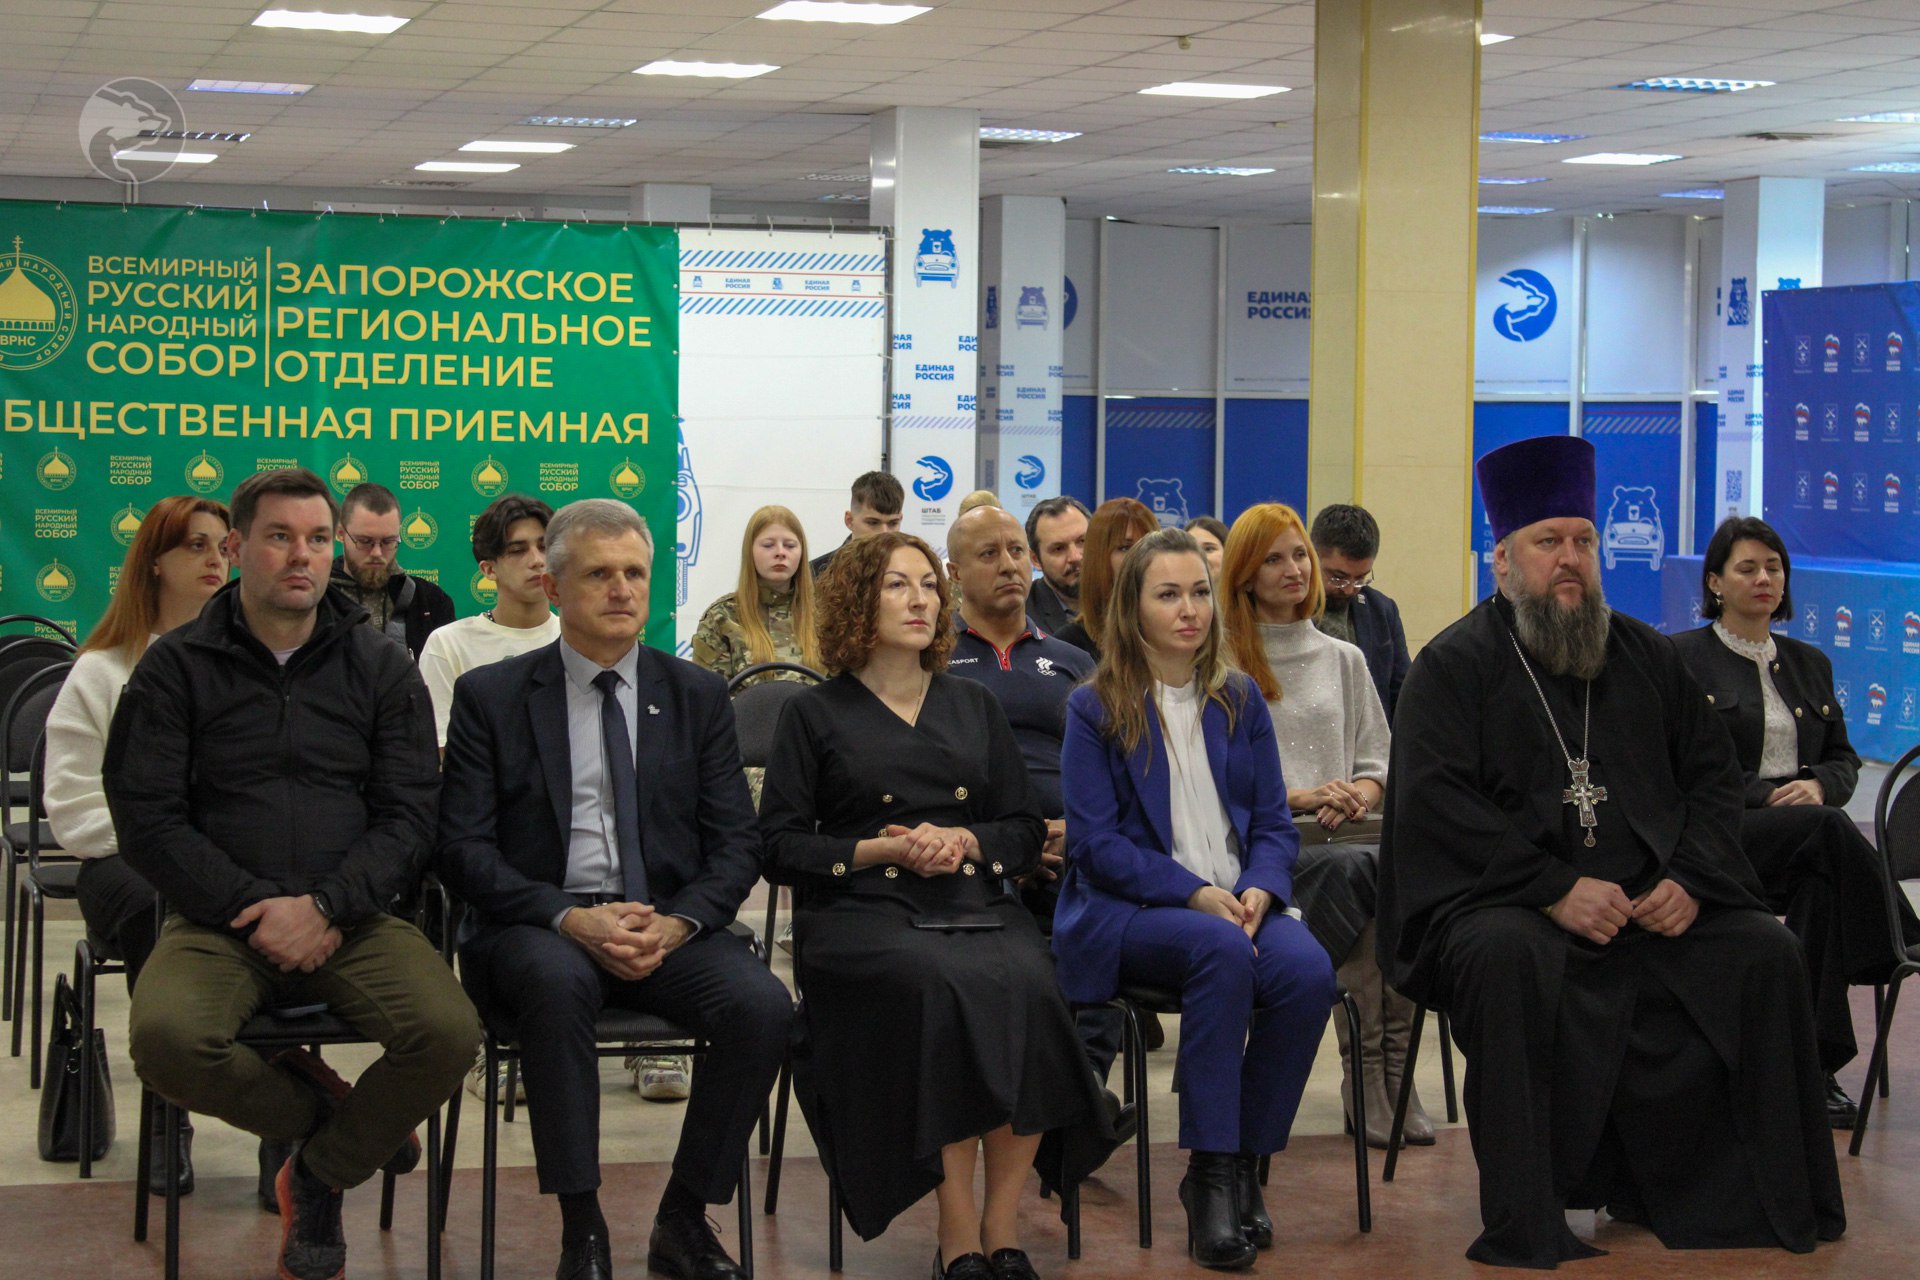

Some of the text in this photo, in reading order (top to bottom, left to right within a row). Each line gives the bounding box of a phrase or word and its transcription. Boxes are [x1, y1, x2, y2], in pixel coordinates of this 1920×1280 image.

[89, 256, 257, 279] ВСЕМИРНЫЙ
[276, 262, 633, 303] ЗАПОРОЖСКОЕ
[88, 280, 257, 311] РУССКИЙ
[1248, 291, 1311, 304] ЕДИНА
[1248, 306, 1311, 319] РОССИ
[88, 313, 257, 339] НАРОДНЫЙ
[278, 306, 651, 347] РЕГИОНАЛЬНОЕ
[0, 335, 36, 346] ВРНС
[87, 341, 256, 377] СОБОР
[275, 351, 553, 390] ОТДЕЛЕНИЕ
[915, 372, 955, 380] РОССИЯ
[391, 408, 649, 444] ПРИЕМНАЯ
[110, 461, 152, 469] РУССКИЙ
[110, 476, 152, 485] СОБОР
[400, 481, 440, 490] СОБОР
[540, 483, 579, 491] СОБОР
[35, 529, 77, 539] СОБОР
